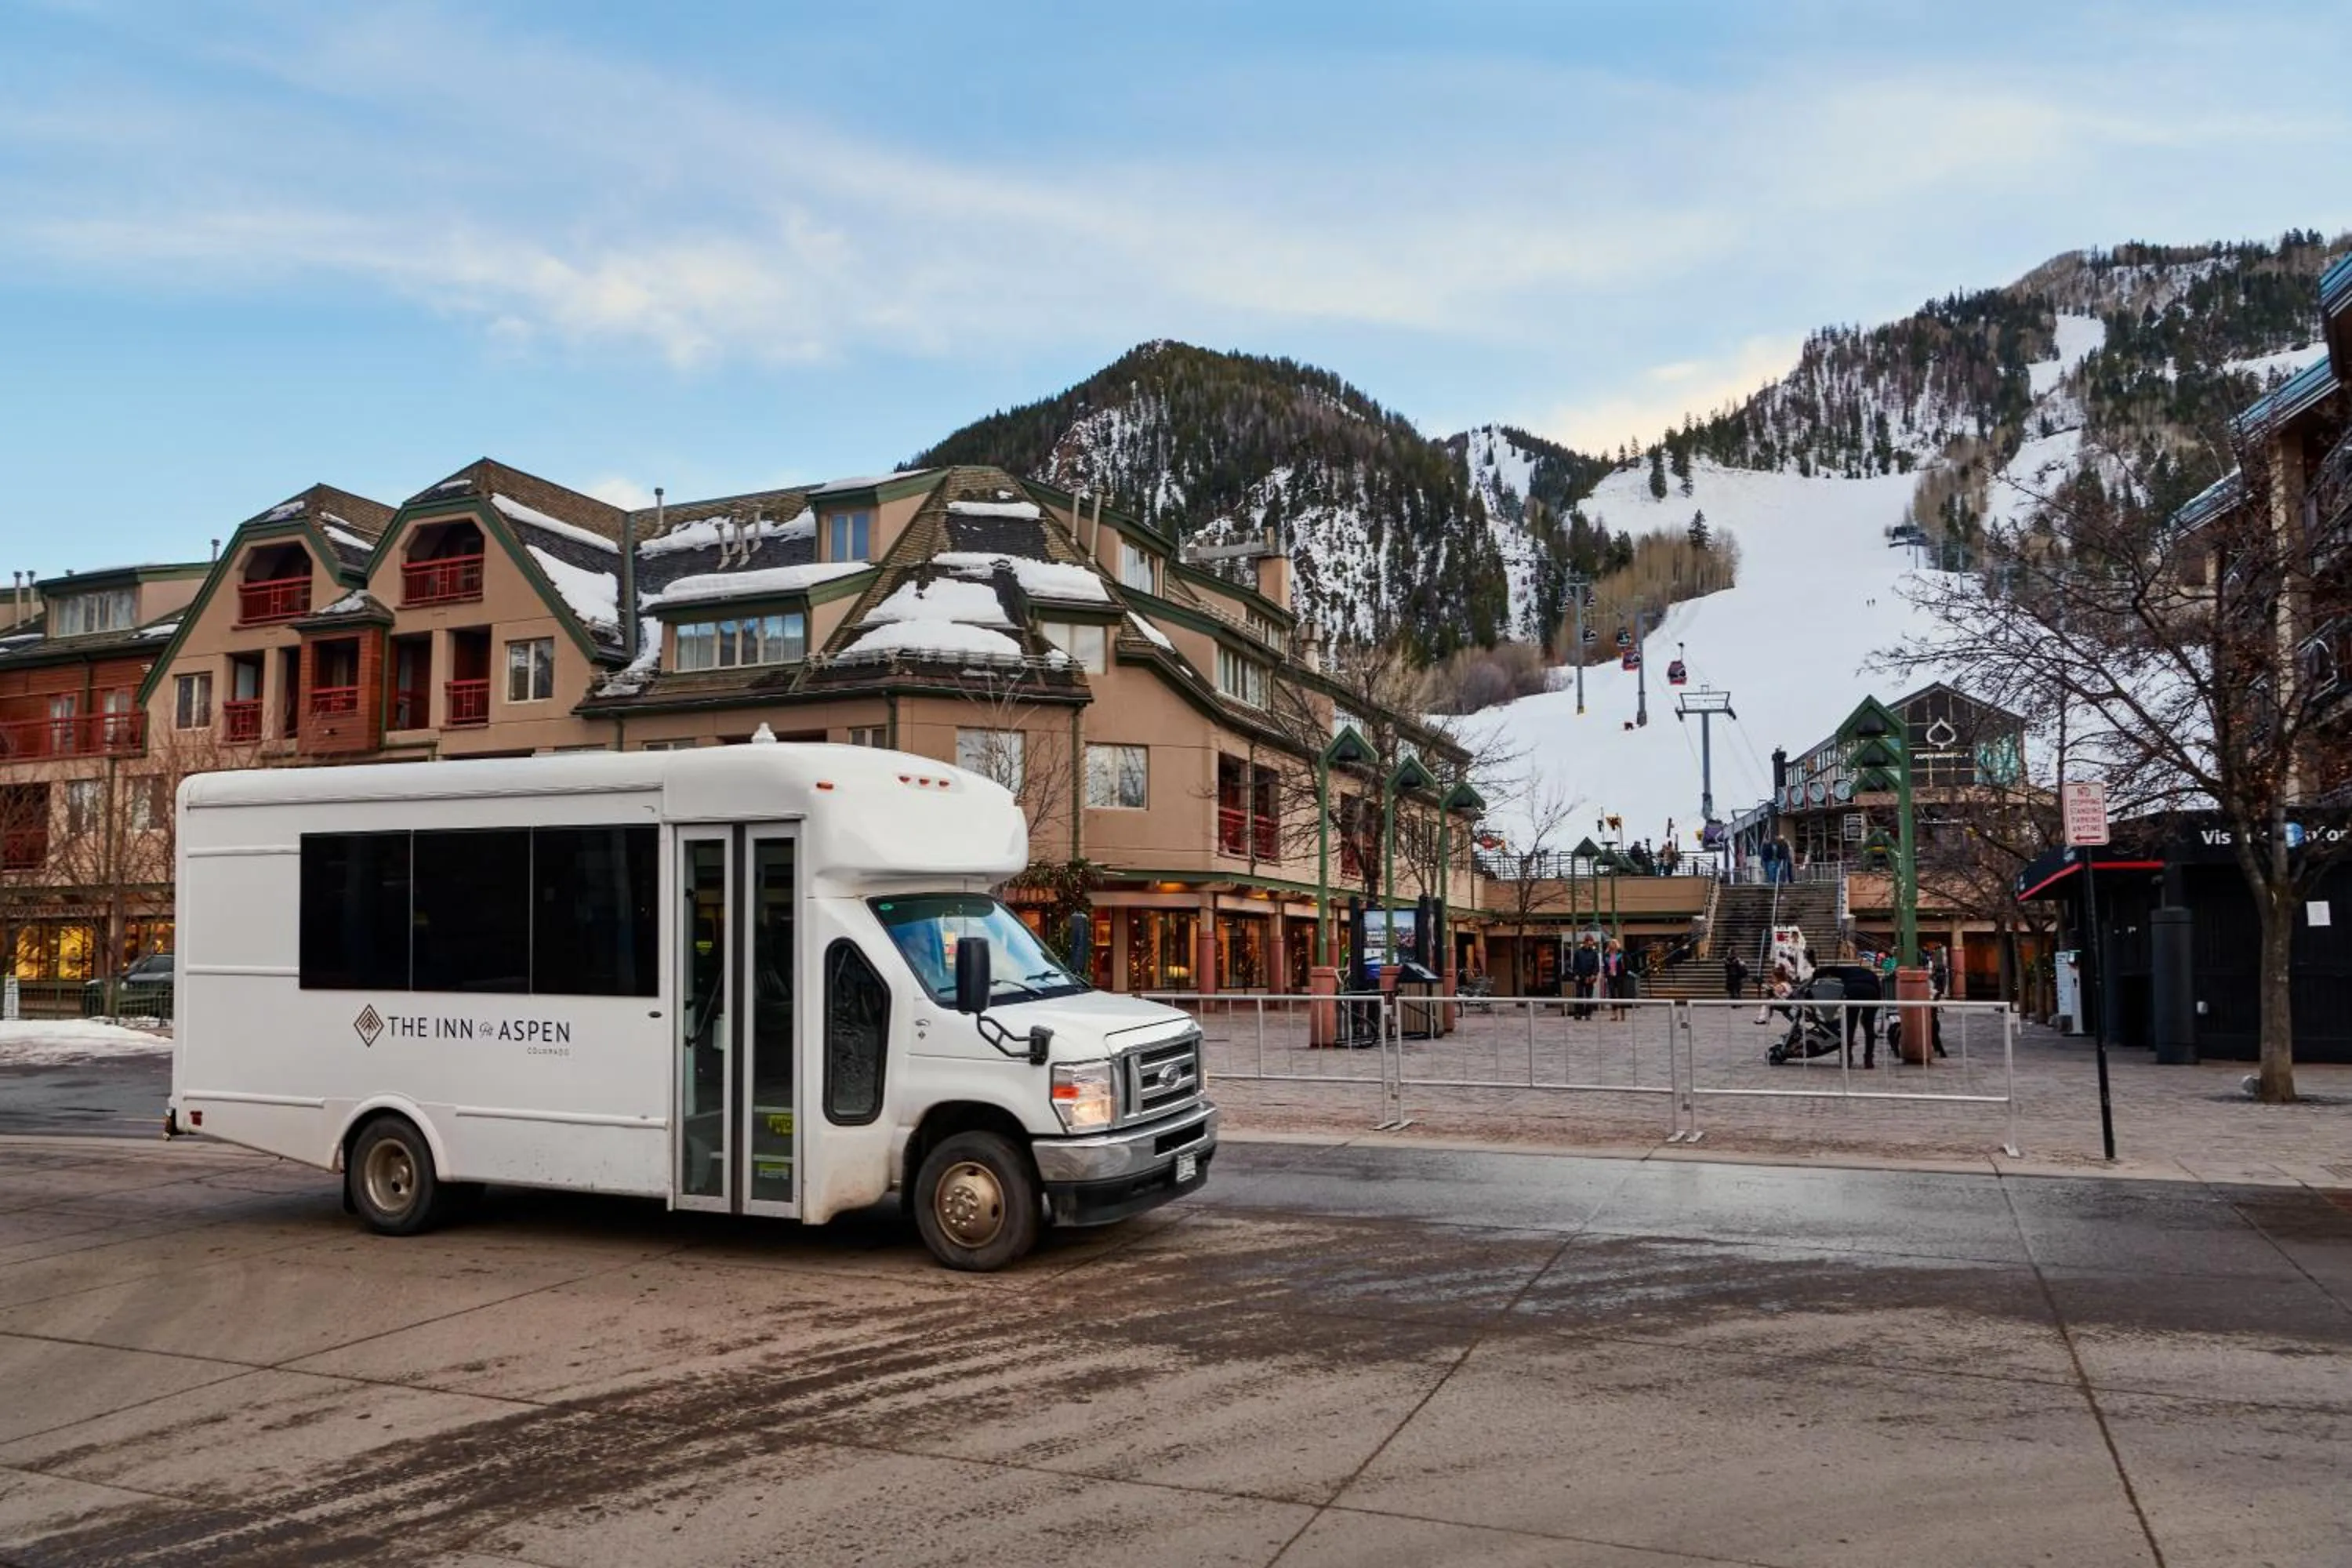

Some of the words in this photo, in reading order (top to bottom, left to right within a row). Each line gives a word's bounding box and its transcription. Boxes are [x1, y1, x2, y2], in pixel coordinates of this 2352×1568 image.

[2076, 786, 2092, 797] NO
[387, 1016, 427, 1037] THE
[436, 1018, 473, 1040] INN
[498, 1020, 570, 1043] ASPEN
